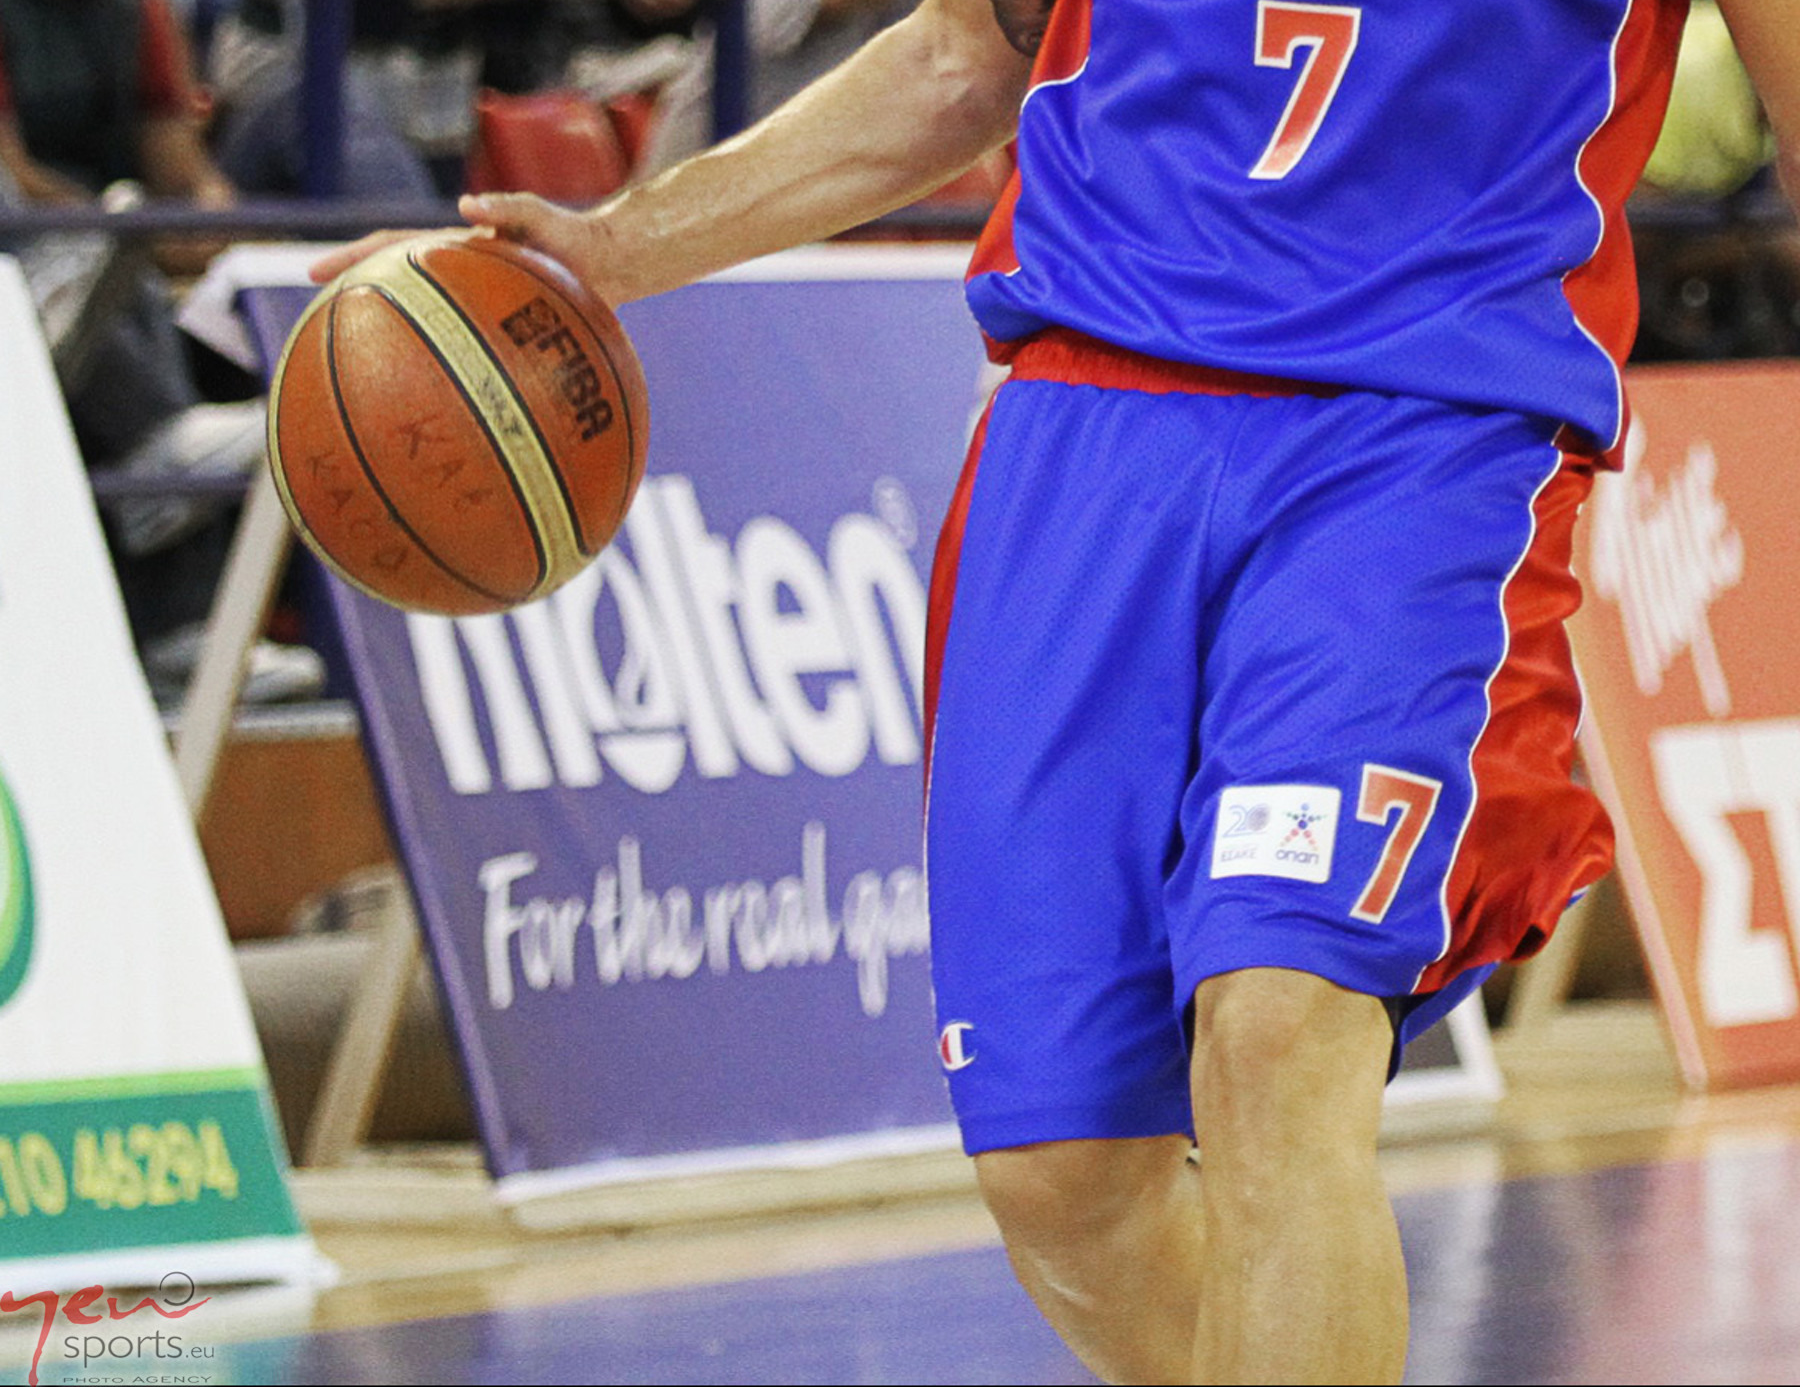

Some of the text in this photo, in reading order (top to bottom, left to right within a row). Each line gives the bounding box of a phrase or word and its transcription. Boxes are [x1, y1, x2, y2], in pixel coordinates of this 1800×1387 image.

[538, 310, 614, 442] FIBA
[406, 474, 927, 795] molten
[478, 852, 587, 1010] For
[592, 835, 704, 984] the
[704, 820, 842, 976] real
[1349, 763, 1443, 925] 7
